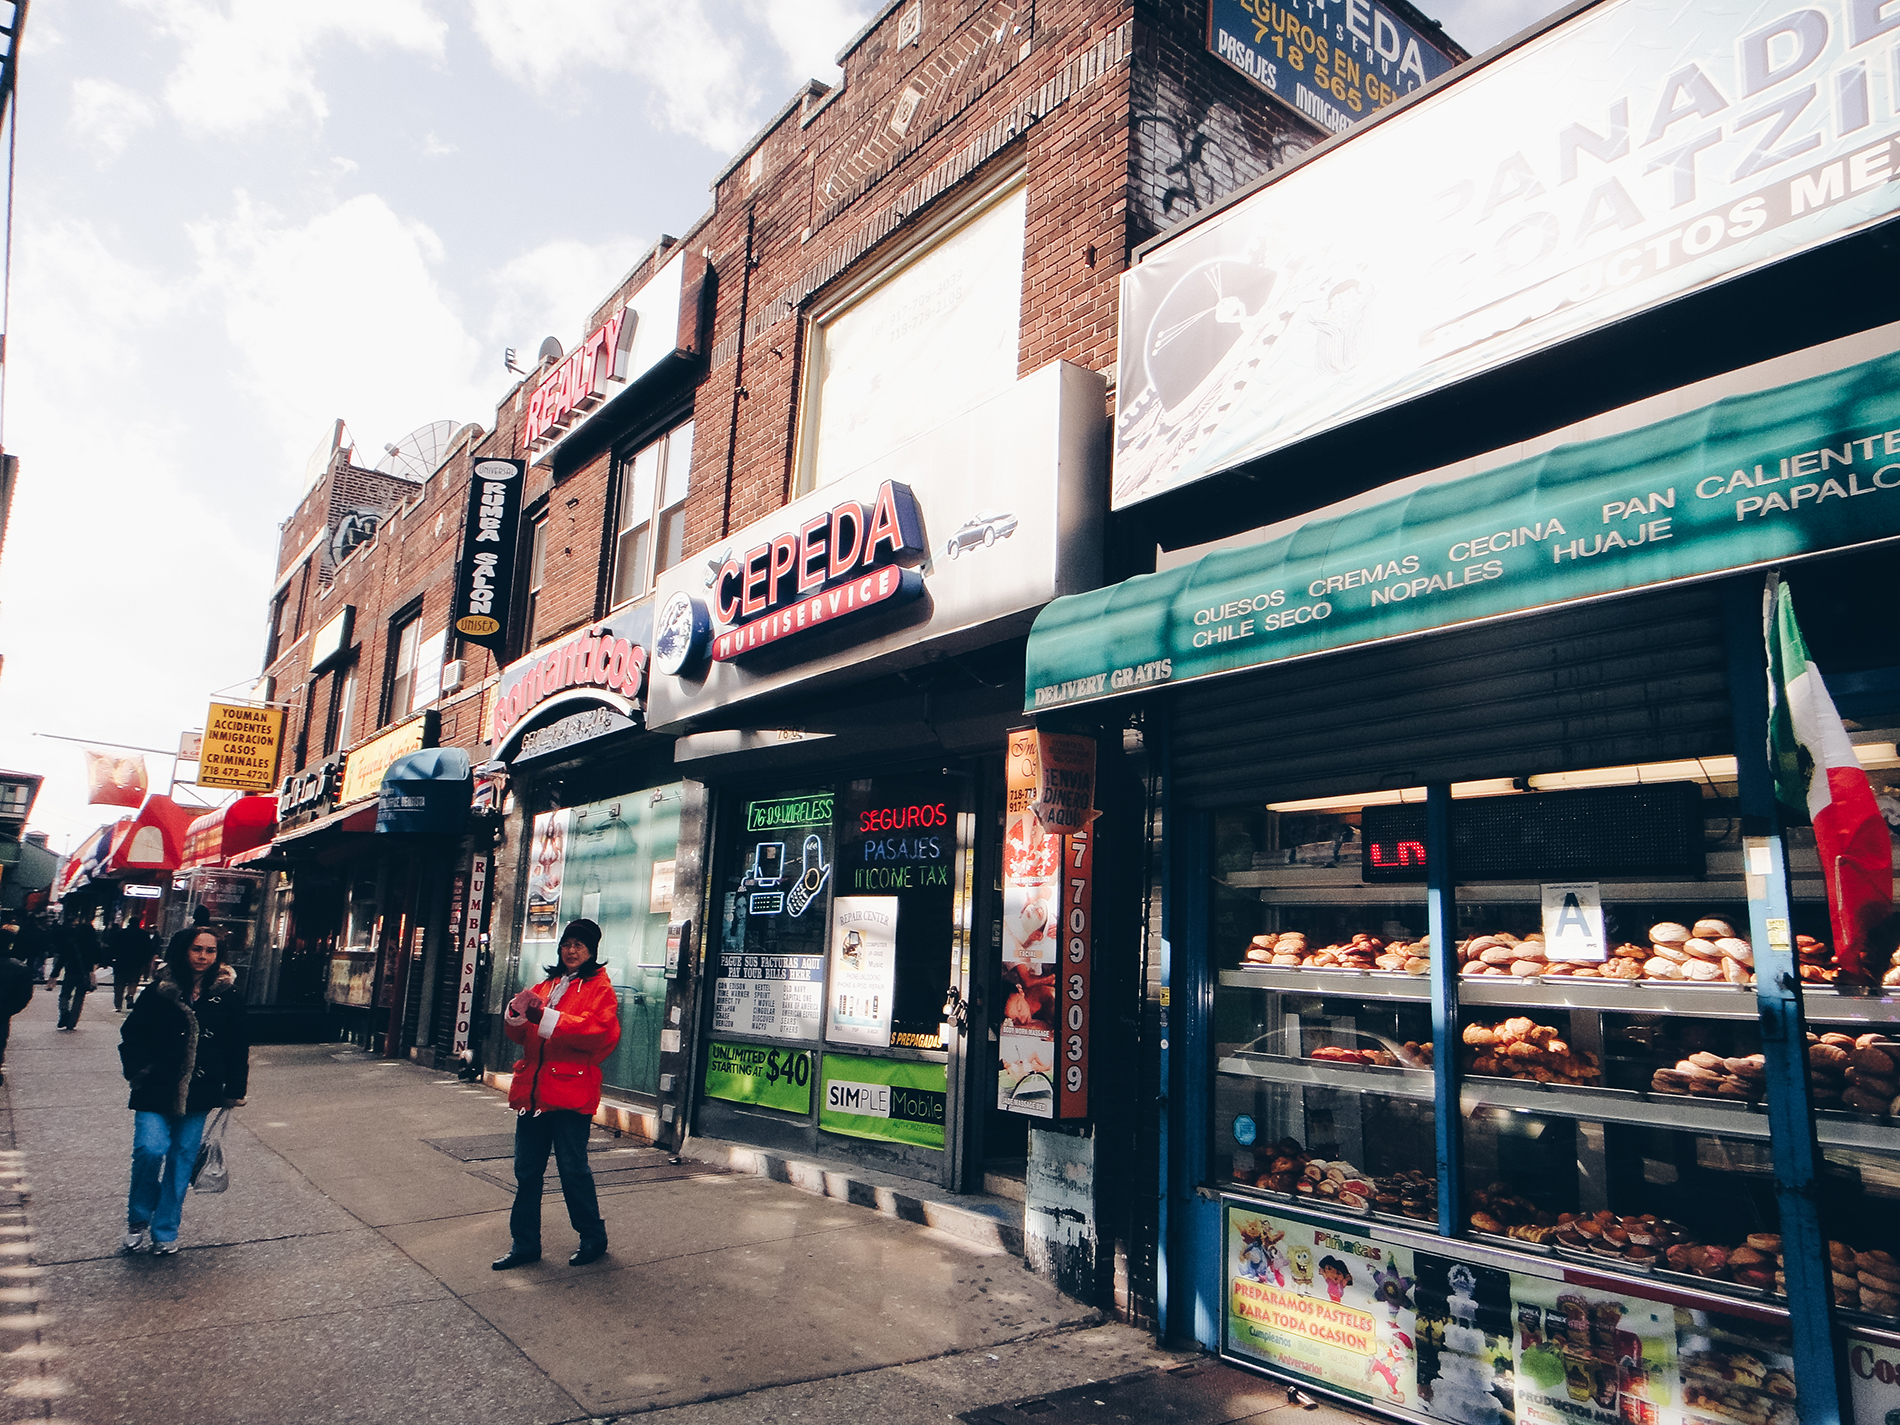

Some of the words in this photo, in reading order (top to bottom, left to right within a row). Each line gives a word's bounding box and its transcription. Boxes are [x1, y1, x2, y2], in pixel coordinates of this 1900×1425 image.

[1218, 28, 1277, 91] PASAJES
[1251, 18, 1305, 72] 718
[1314, 64, 1363, 112] 565
[1335, 48, 1361, 88] EN
[523, 307, 628, 450] REALTY
[478, 465, 515, 476] UNIVERSAL
[475, 481, 507, 542] RUMBA
[1602, 487, 1676, 524] PAN
[715, 478, 905, 625] CEPEDA
[469, 552, 498, 614] SALON
[1193, 589, 1286, 626] QUESOS
[1308, 554, 1420, 597] CREMAS
[1448, 517, 1567, 562] CECINA
[1193, 619, 1255, 648] CHILE
[1264, 601, 1332, 631] SECO
[1371, 559, 1504, 607] NOPALES
[1553, 517, 1673, 564] HUAJE
[460, 619, 494, 632] UNISEX
[719, 569, 890, 658] MULTISERVICE
[1034, 673, 1107, 706] DELIVERY
[1111, 658, 1172, 689] GRATIS
[213, 720, 272, 734] ACCIDENTES
[222, 708, 268, 722] YOUMAN
[209, 730, 274, 746] INMIGRACION
[223, 744, 256, 755] CASOS
[203, 765, 219, 775] 718
[206, 754, 269, 768] CRIMINALES
[1043, 787, 1090, 810] DINERO
[860, 803, 947, 832] SEGUROS
[864, 836, 940, 861] PASAJES
[855, 866, 913, 889] INCOME
[919, 865, 947, 886] TAX
[467, 861, 485, 949] RUMBA
[839, 911, 863, 926] REPAIR
[863, 910, 890, 926] CENTER
[1555, 892, 1593, 937] A
[720, 956, 742, 967] PAGUE
[744, 956, 758, 967] SUS
[761, 957, 799, 969] FACTURAS
[801, 958, 820, 970] AQUI
[1018, 950, 1037, 958] FACIAL
[728, 967, 741, 978] PAY
[743, 968, 762, 979] YOUR
[765, 968, 787, 980] BILLS
[789, 969, 811, 981] HERE
[754, 984, 771, 992] NEXTEL
[456, 962, 474, 1051] SALON
[896, 1032, 943, 1049] PREPAGADAS
[711, 1062, 752, 1077] STARTING
[752, 1066, 763, 1078] AT
[712, 1045, 766, 1064] UNLIMITED
[765, 1048, 809, 1087] $40
[829, 1085, 887, 1112] SIMPLE
[892, 1090, 944, 1120] Mobile
[1314, 1231, 1381, 1260] Piñatas
[1234, 1282, 1314, 1315] PREPARAMOS
[1316, 1304, 1373, 1332] PASTELES
[1239, 1302, 1271, 1322] PARA
[1272, 1312, 1306, 1331] TODA
[1309, 1323, 1368, 1350] OCASION
[1249, 1326, 1292, 1348] Cumpleaños
[1277, 1352, 1323, 1375] Aniversarios
